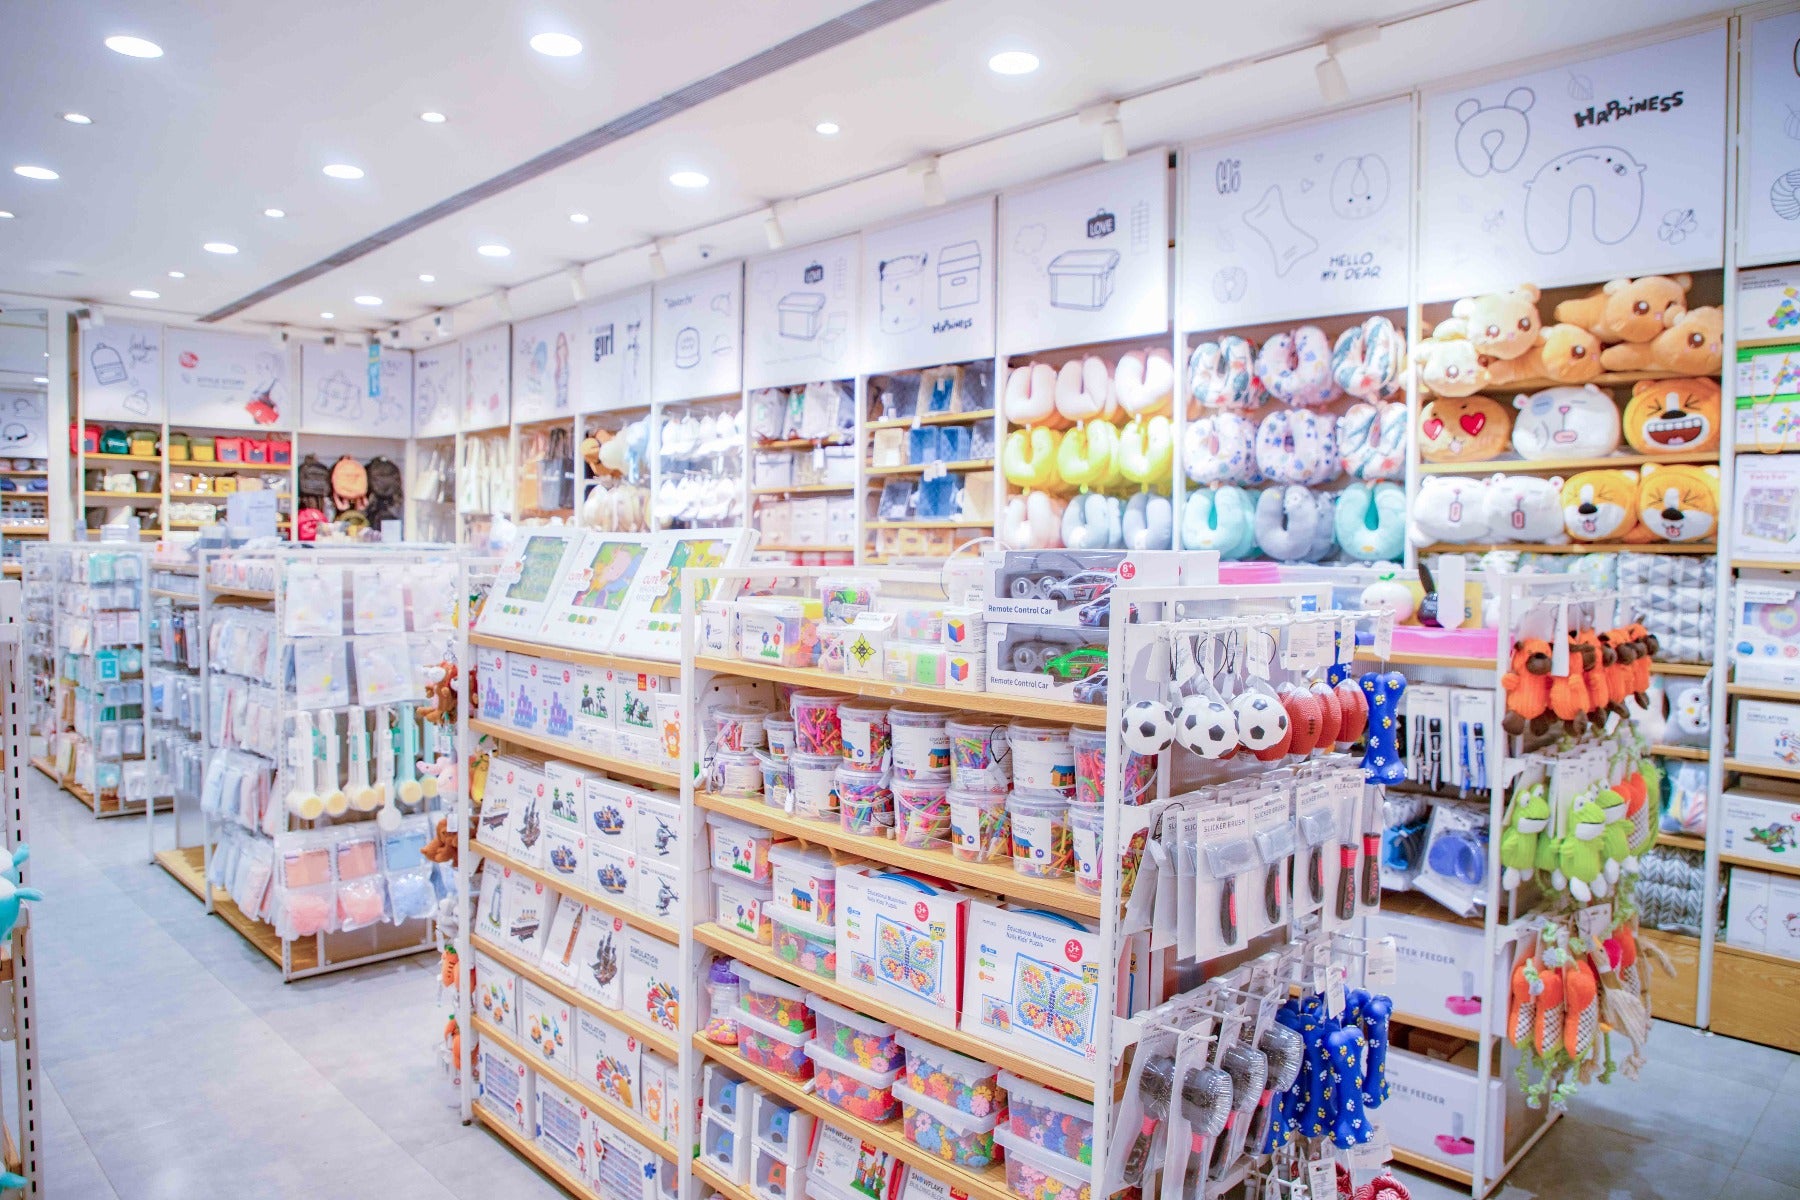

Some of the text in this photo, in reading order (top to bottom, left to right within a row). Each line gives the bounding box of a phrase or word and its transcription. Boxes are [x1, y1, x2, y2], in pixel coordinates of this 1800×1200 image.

[1330, 252, 1374, 267] HELLO
[1344, 265, 1382, 281] DEAR
[988, 605, 1013, 613] Remote
[1014, 606, 1039, 614] Control
[990, 676, 1014, 686] Remote
[1014, 679, 1037, 688] Control
[1203, 819, 1246, 833] SLICKER BRUSH
[1007, 924, 1057, 944] Educational Mushroom
[1029, 938, 1044, 948] Puzzle
[1068, 941, 1080, 953] 3+
[1396, 947, 1455, 964] ATER FEEDER
[1082, 964, 1099, 974] Funn
[1392, 1082, 1445, 1105] TER FEEDER
